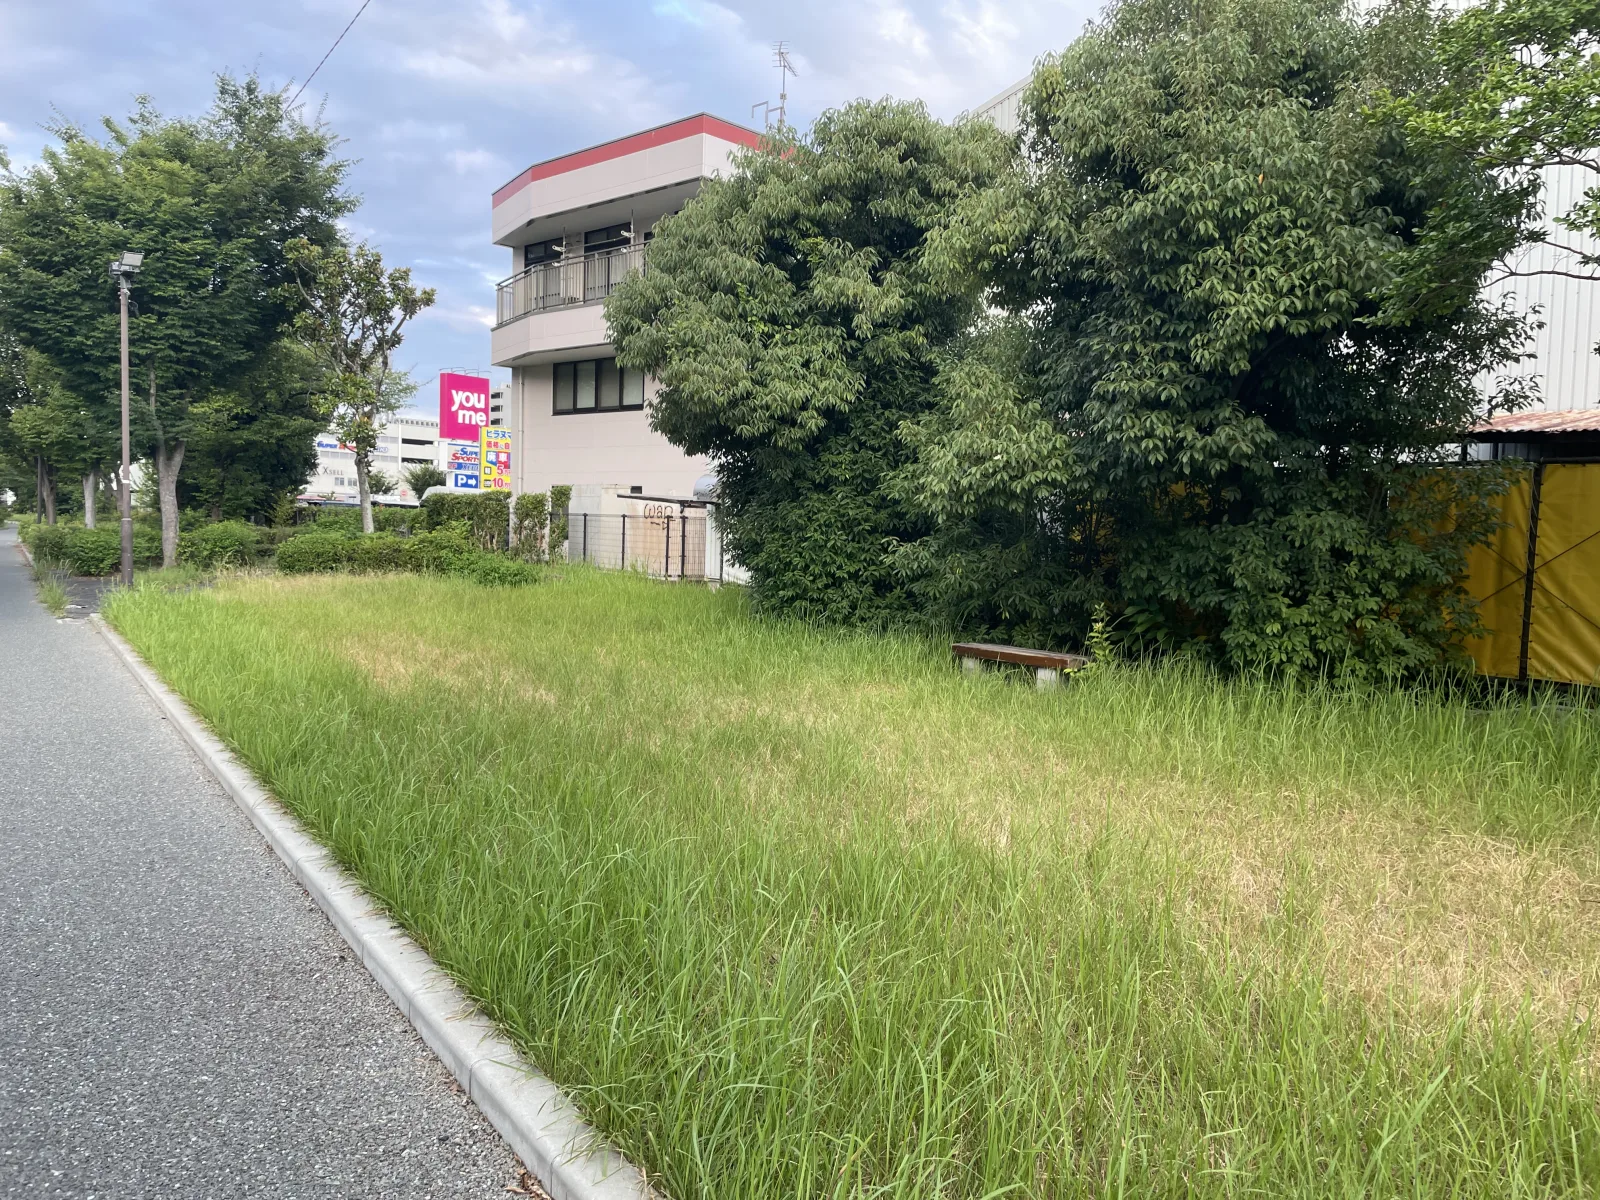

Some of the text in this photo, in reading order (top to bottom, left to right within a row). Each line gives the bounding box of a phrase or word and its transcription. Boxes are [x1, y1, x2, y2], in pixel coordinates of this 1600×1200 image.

[451, 389, 486, 412] you
[457, 409, 487, 426] me
[457, 474, 468, 487] P
